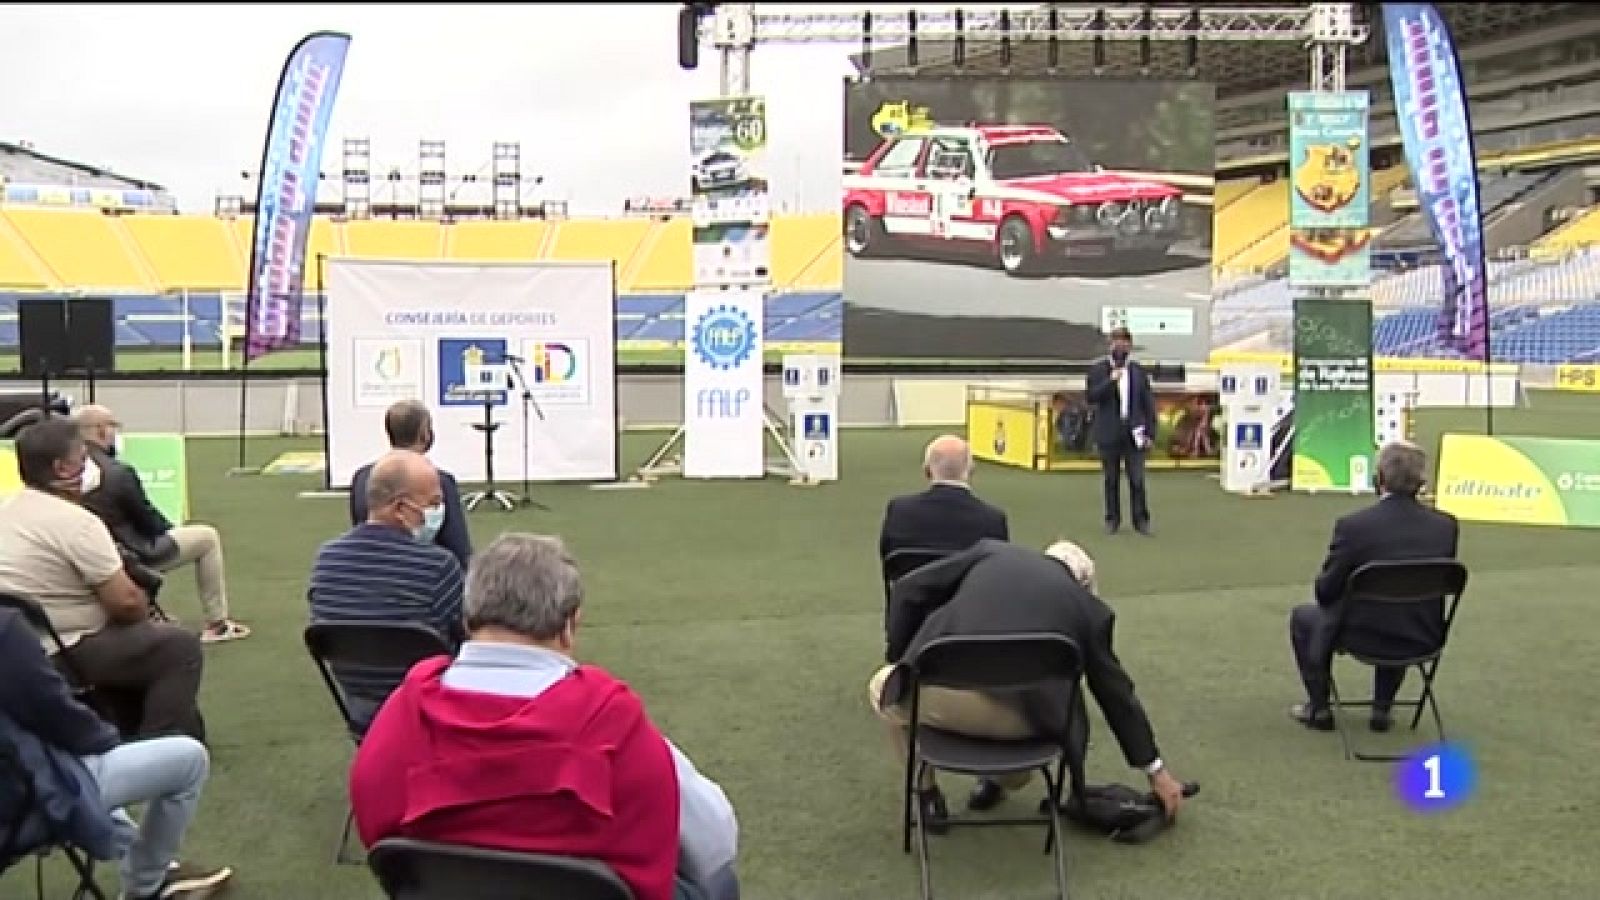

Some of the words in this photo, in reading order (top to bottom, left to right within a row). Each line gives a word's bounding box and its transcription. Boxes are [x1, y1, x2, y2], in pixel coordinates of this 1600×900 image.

[386, 310, 467, 324] CONSEJERÍA
[470, 312, 486, 324] DE
[489, 312, 556, 325] DEPORTES
[1445, 480, 1542, 499] ultimate
